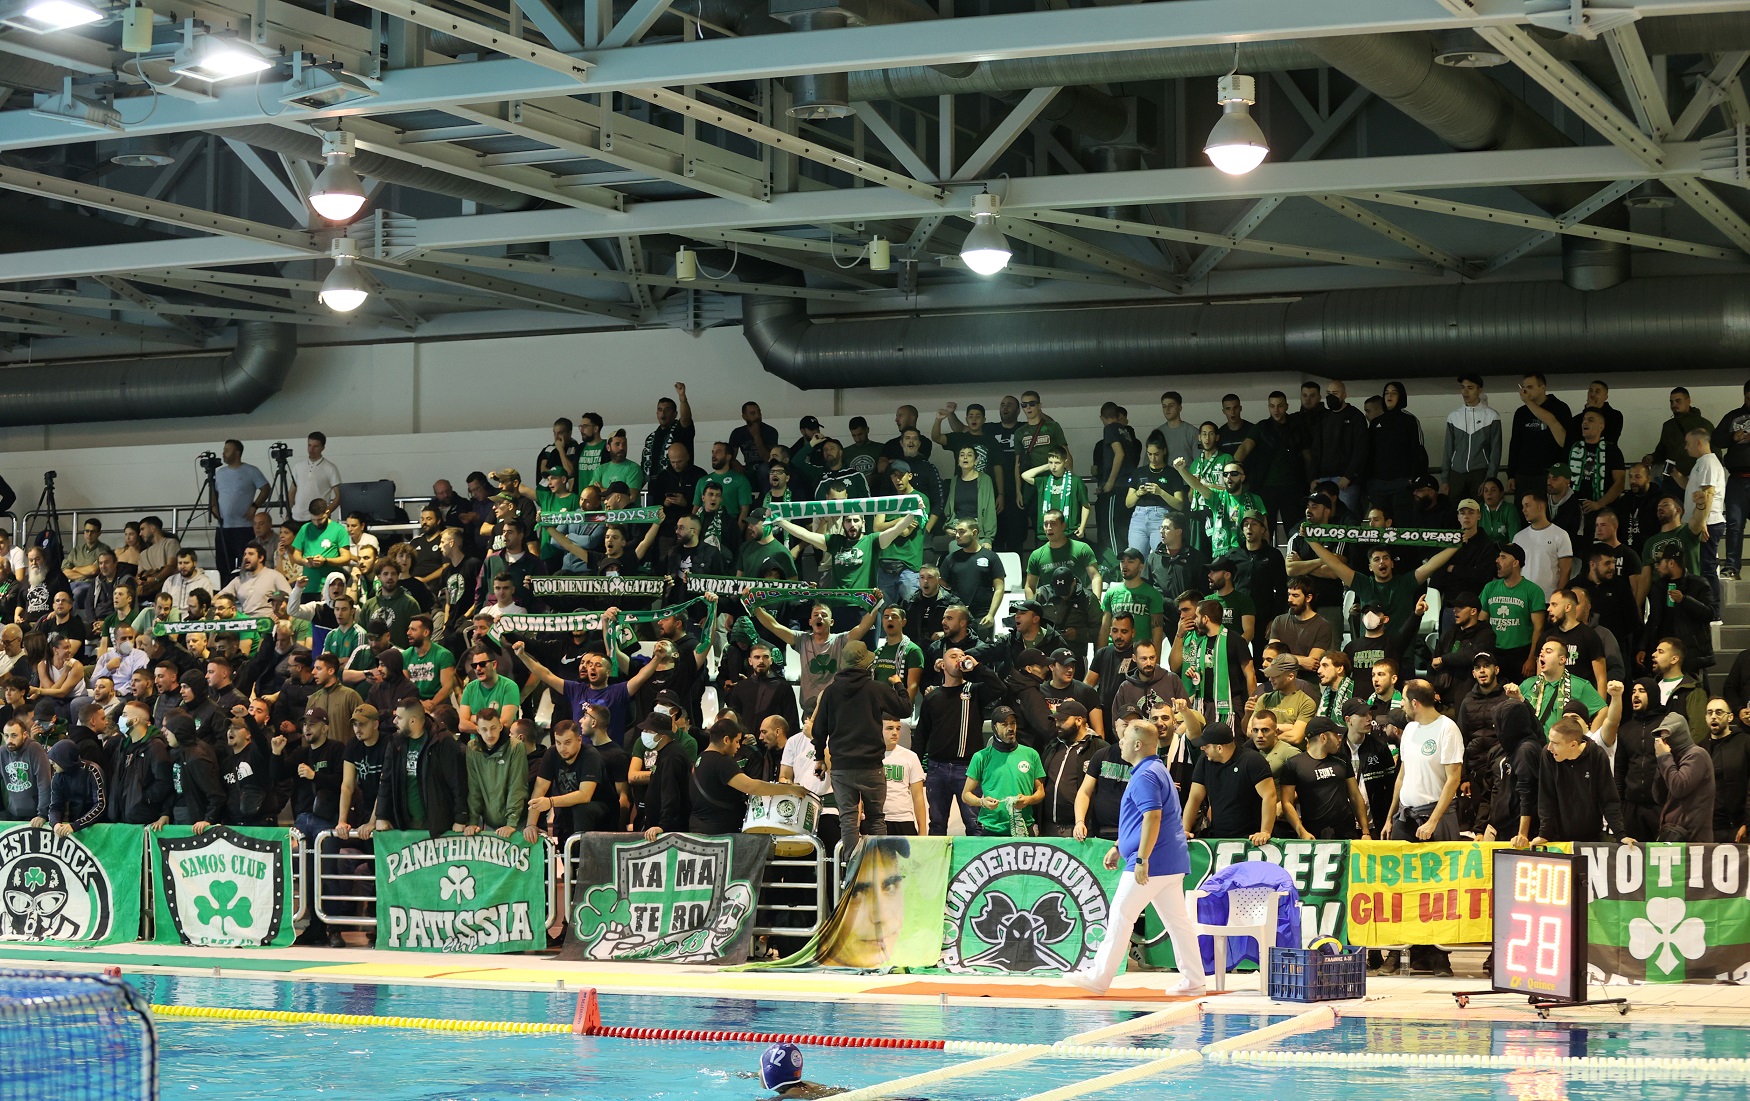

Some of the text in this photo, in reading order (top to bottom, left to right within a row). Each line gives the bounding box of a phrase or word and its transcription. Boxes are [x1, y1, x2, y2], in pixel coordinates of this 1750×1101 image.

[551, 513, 584, 524] MAD
[606, 510, 646, 522] BOYS
[1306, 527, 1462, 544] VOLOS CLUB 40 YEARS
[533, 579, 609, 594] IGOUMENITSA
[1, 830, 98, 885] EST BLOCK
[180, 854, 267, 880] SAMOS CLUB
[386, 835, 531, 884] PANATHINAIKOS
[631, 859, 713, 888] KA MA
[1351, 844, 1484, 886] LIBERTÀ
[1581, 844, 1750, 904] NOTIO
[946, 845, 1108, 921] UNDERGROUND
[1514, 861, 1572, 906] 8:00
[388, 901, 533, 948] PATISSIA
[634, 905, 660, 933] TE
[1351, 888, 1492, 925] GLI ULT
[1505, 912, 1562, 976] 28
[1527, 977, 1556, 991] Quince
[769, 1048, 786, 1067] 12
